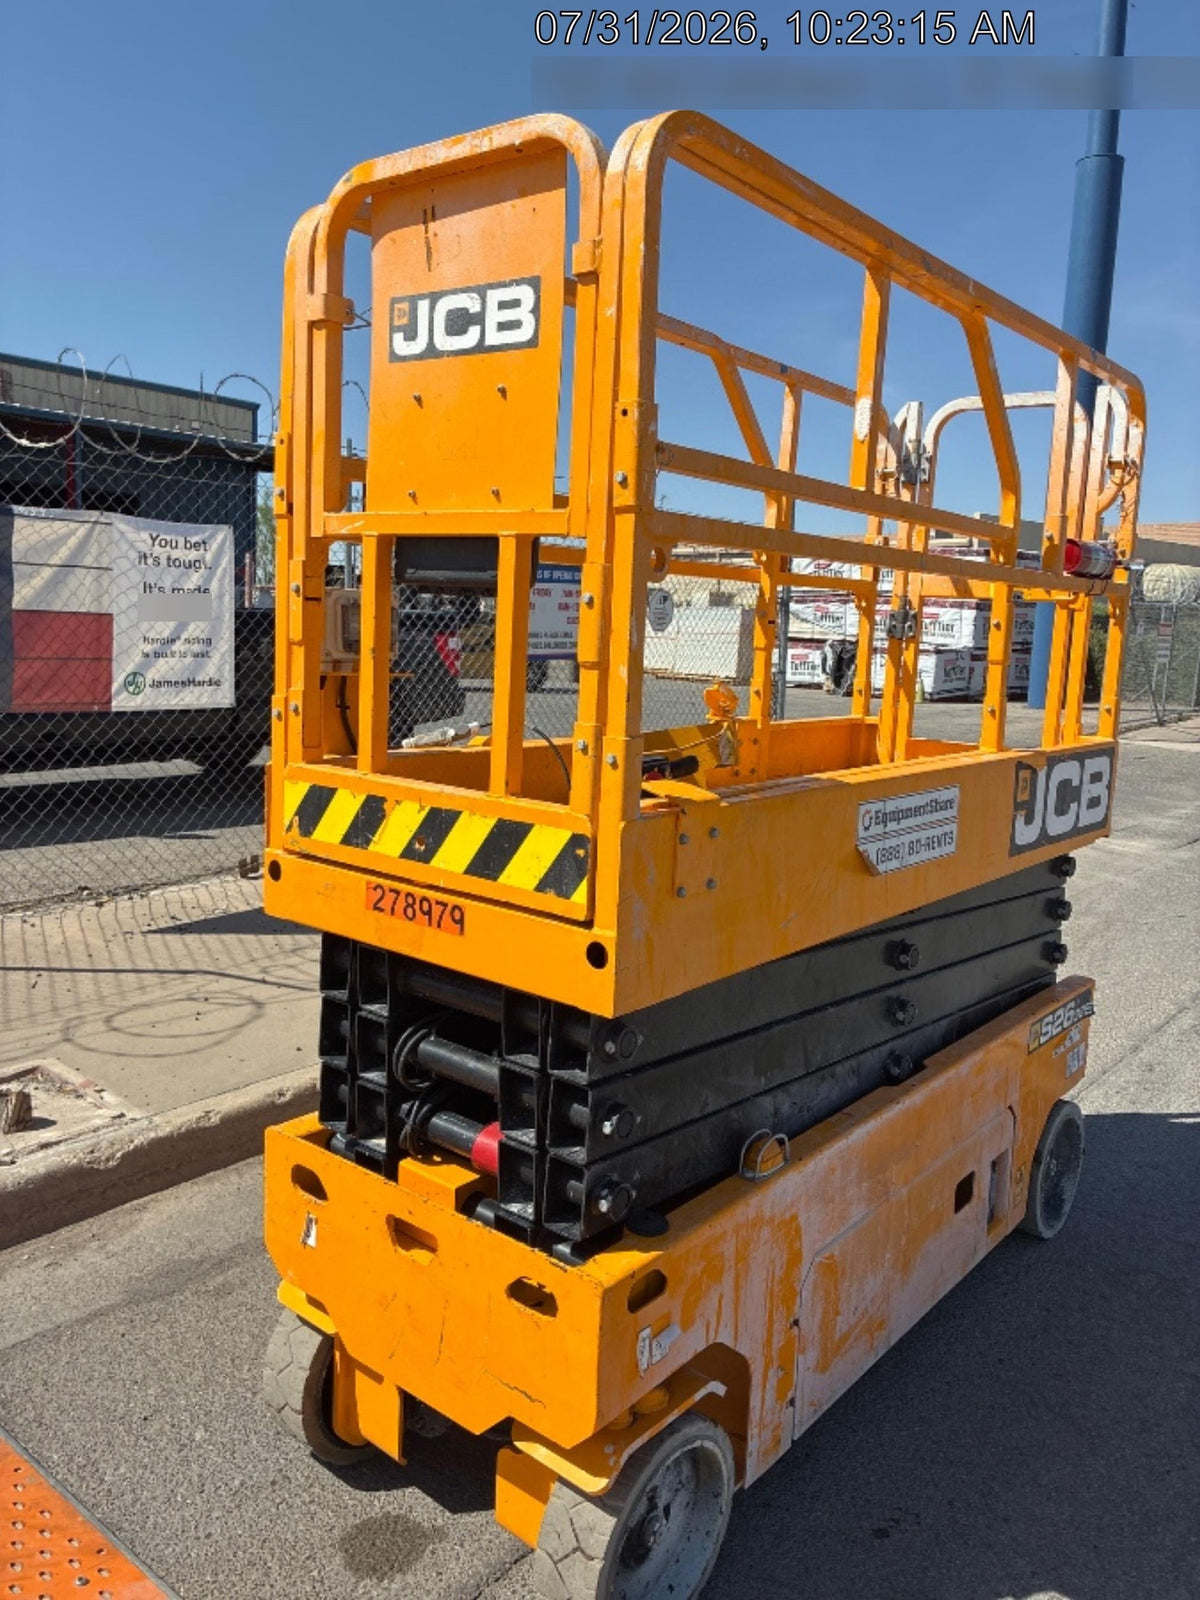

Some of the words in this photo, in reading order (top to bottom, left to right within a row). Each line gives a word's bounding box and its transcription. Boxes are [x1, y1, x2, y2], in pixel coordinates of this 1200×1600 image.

[392, 284, 536, 357] JCB
[149, 533, 179, 550] You
[184, 536, 209, 552] bet
[137, 551, 161, 567] it's
[148, 676, 222, 689] JamesHardie
[874, 797, 955, 828] EquipmentShare
[1014, 754, 1110, 846] JCB
[372, 883, 465, 936] 278979
